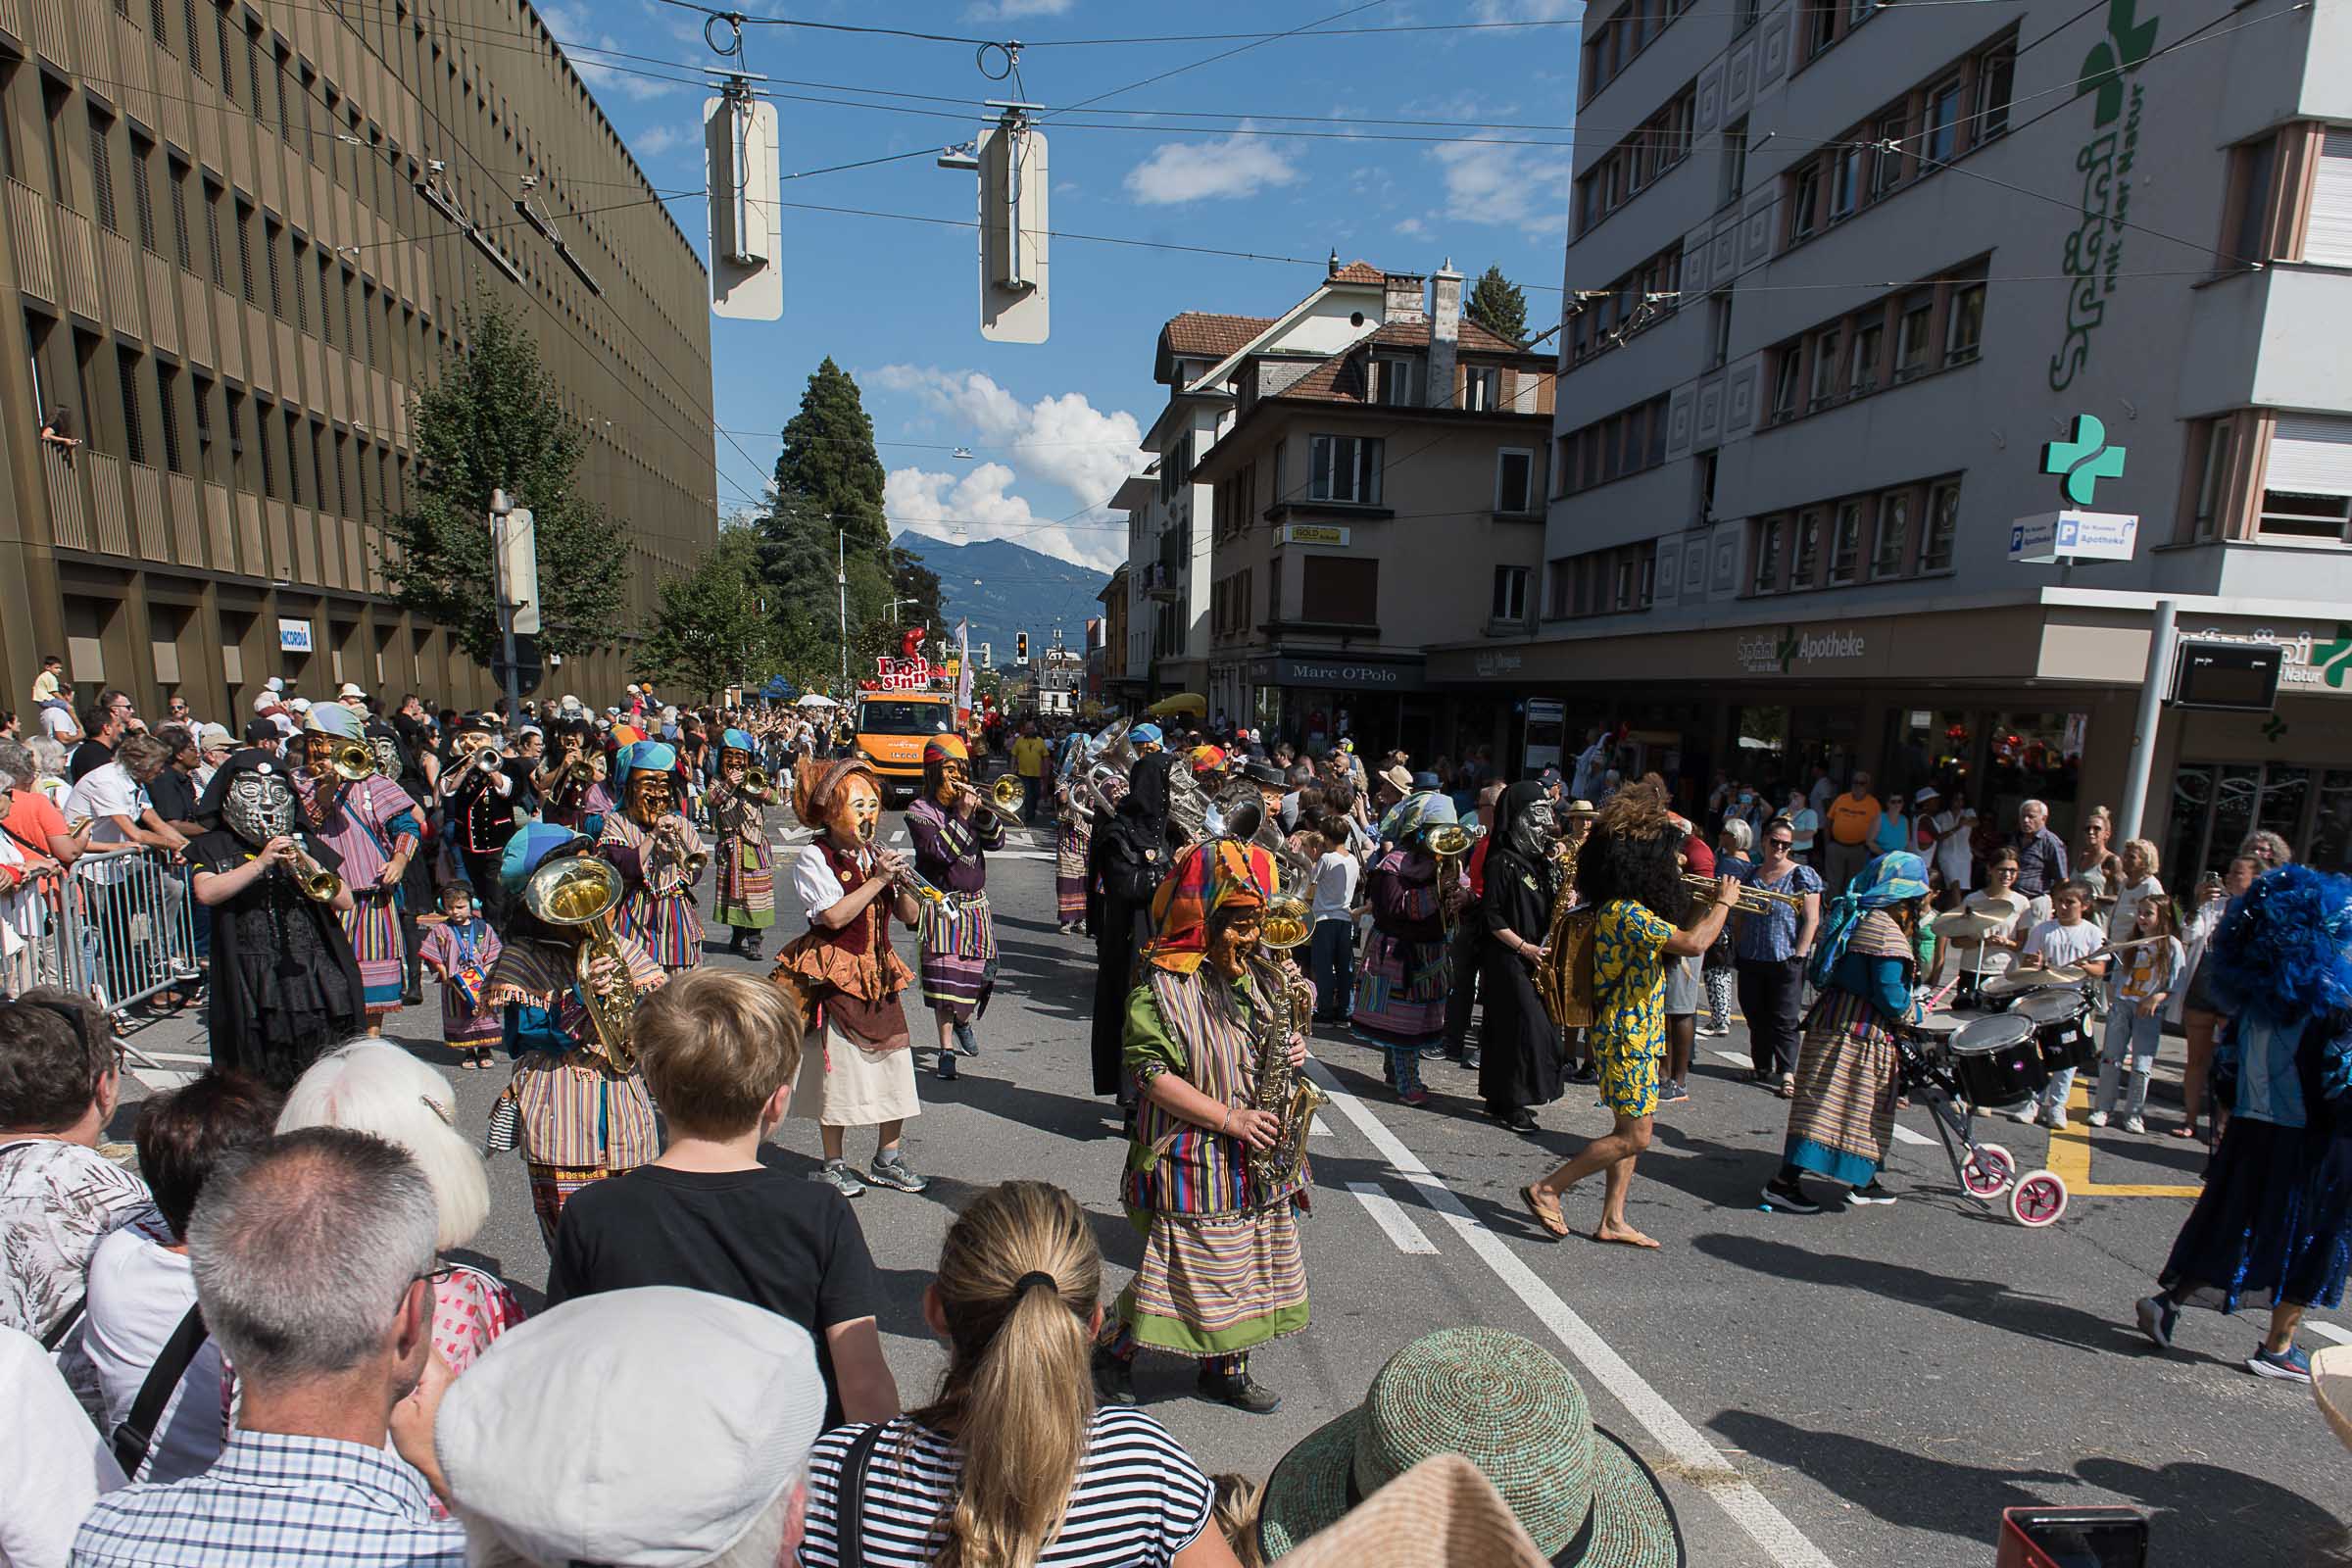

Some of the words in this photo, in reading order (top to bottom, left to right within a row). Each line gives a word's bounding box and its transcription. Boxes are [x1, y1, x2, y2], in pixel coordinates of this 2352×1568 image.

[2117, 82, 2144, 176] Natur
[1798, 630, 1865, 664] Apotheke
[883, 672, 927, 689] sinn
[1293, 664, 1338, 679] Marc
[1342, 666, 1397, 683] O'Polo
[2281, 665, 2322, 683] Natur
